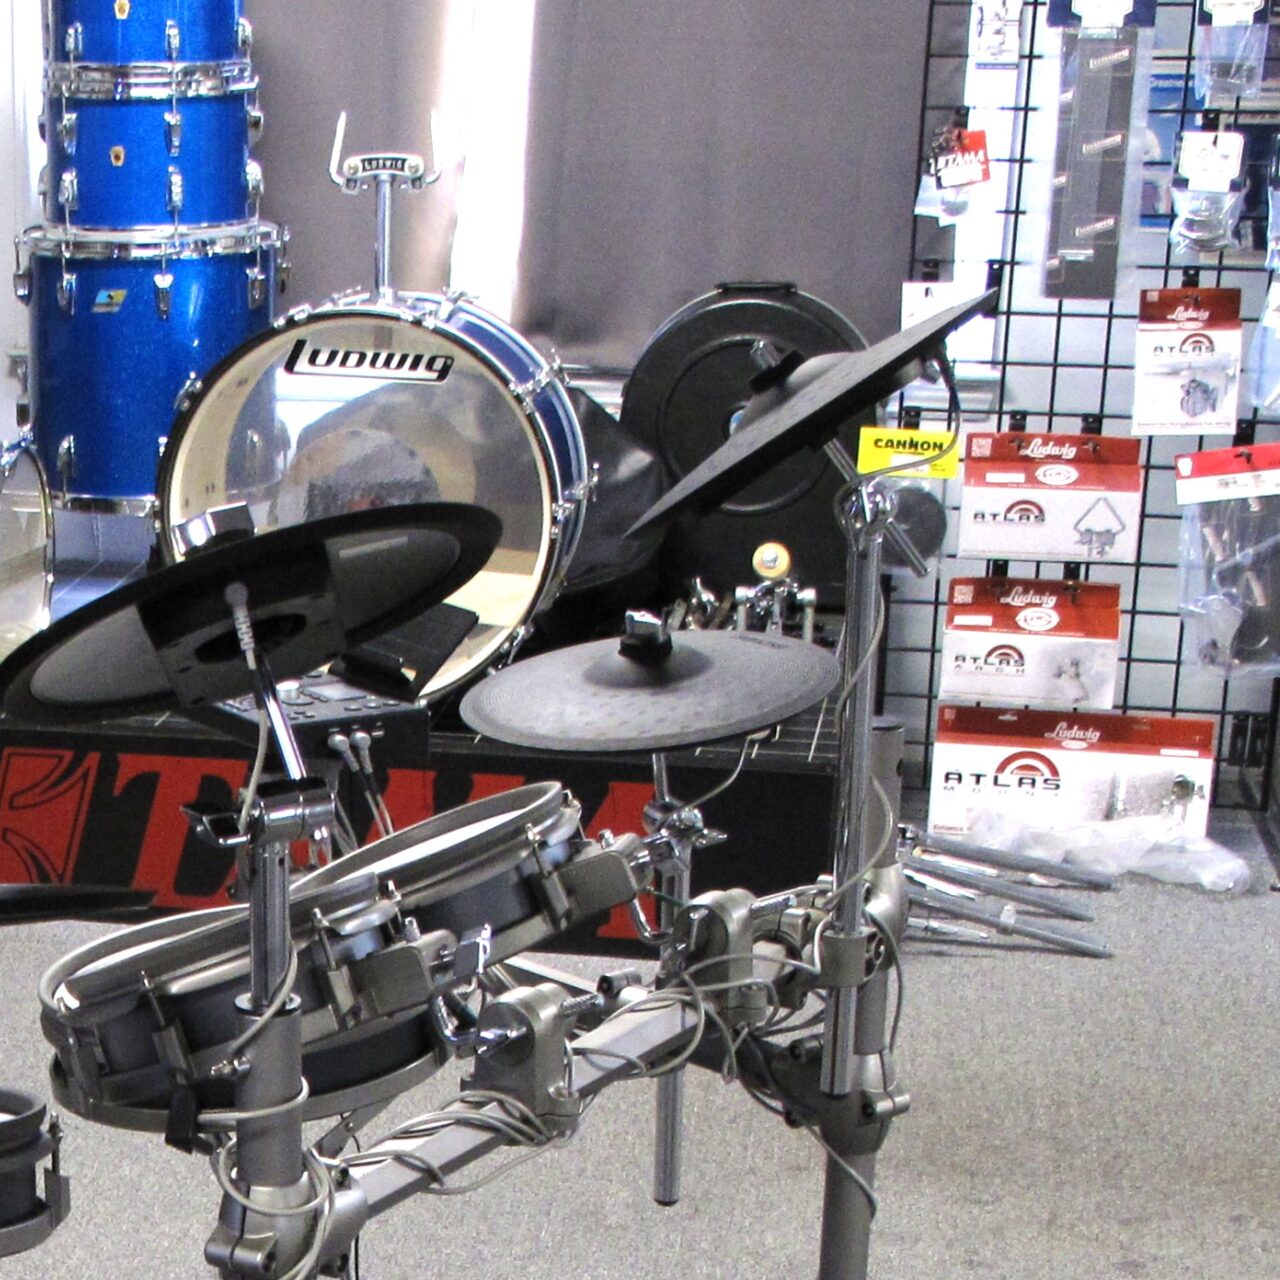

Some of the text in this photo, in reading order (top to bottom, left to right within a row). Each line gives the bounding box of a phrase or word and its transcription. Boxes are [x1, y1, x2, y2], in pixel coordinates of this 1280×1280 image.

[1166, 305, 1210, 321] Ludwig
[873, 437, 944, 451] CANNON
[1019, 438, 1078, 460] Ludwig
[973, 512, 1045, 522] ATLAS
[1000, 586, 1057, 608] Ludwig
[954, 655, 1025, 667] ATLAS
[1044, 721, 1101, 743] Ludwig
[944, 771, 1061, 791] ATLAS
